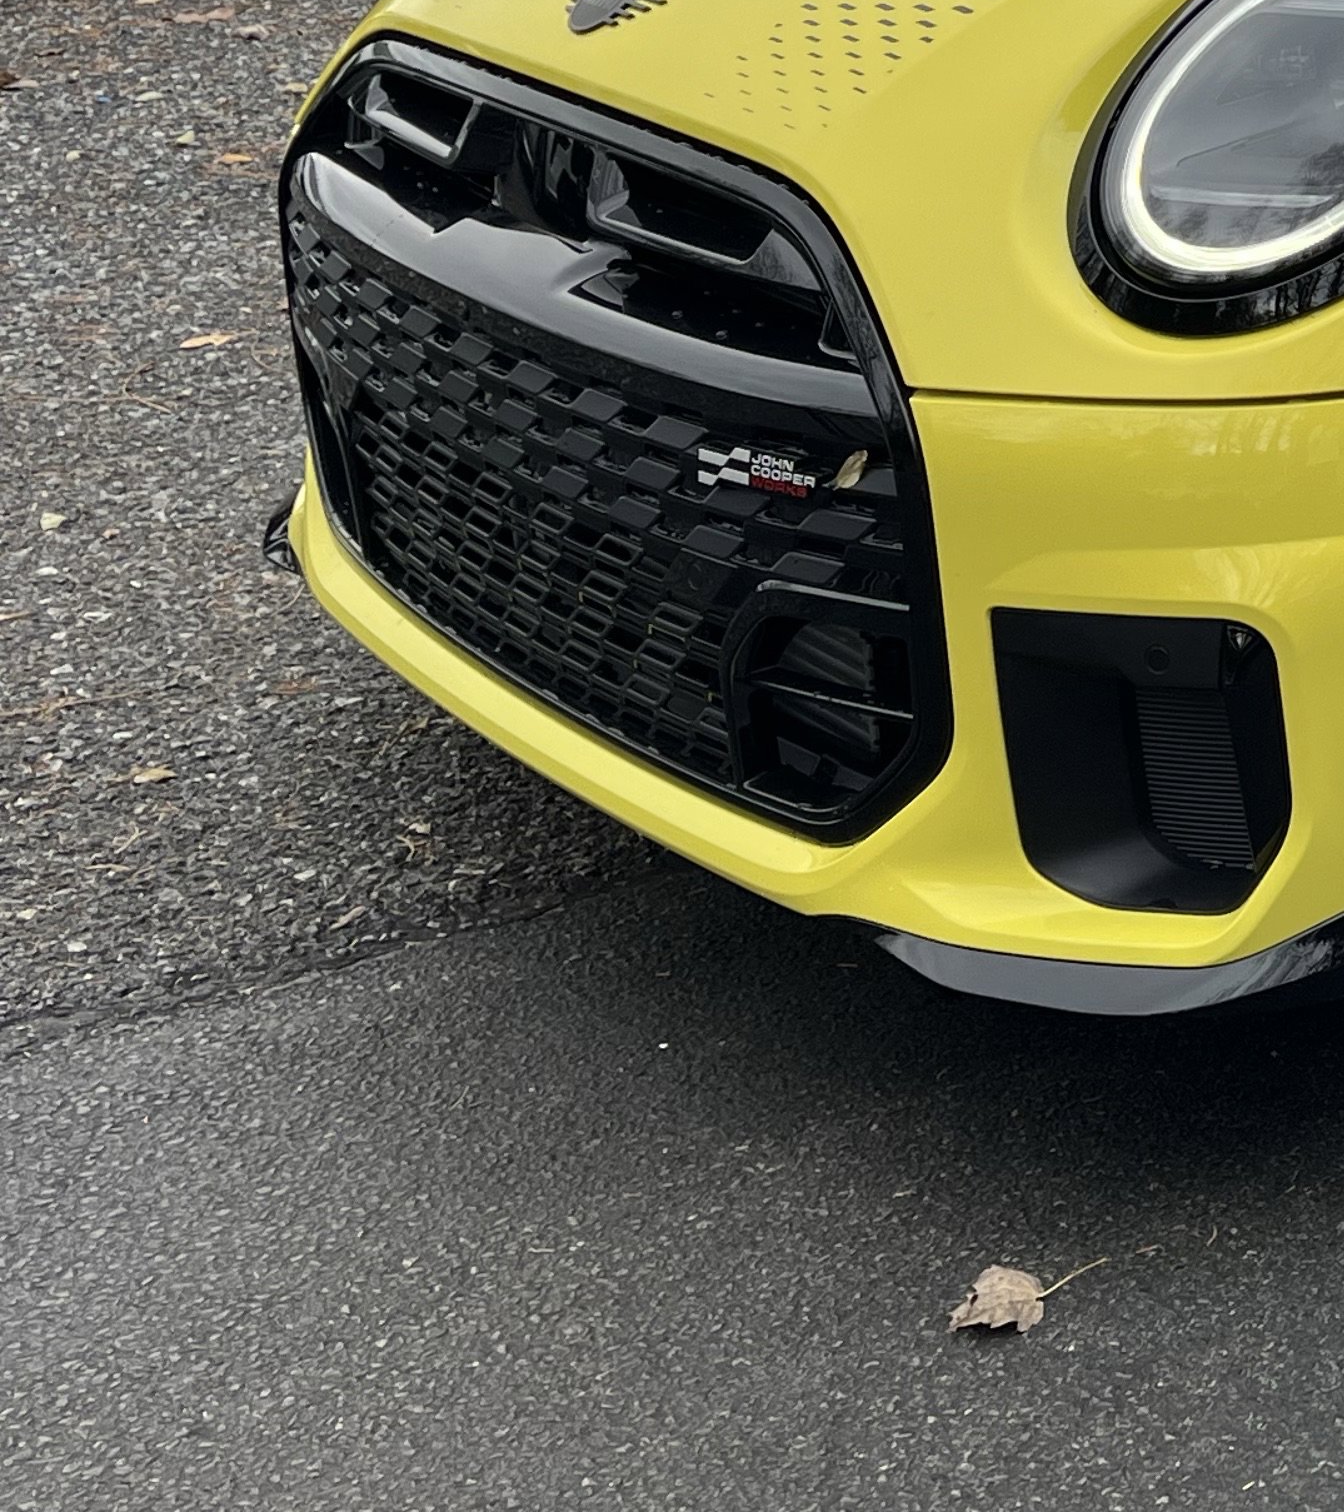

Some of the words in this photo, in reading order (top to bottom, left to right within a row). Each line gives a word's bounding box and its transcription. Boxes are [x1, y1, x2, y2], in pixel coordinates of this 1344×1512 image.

[751, 453, 794, 473] JOHN
[750, 465, 816, 489] COOPER
[751, 476, 808, 499] WORKS
